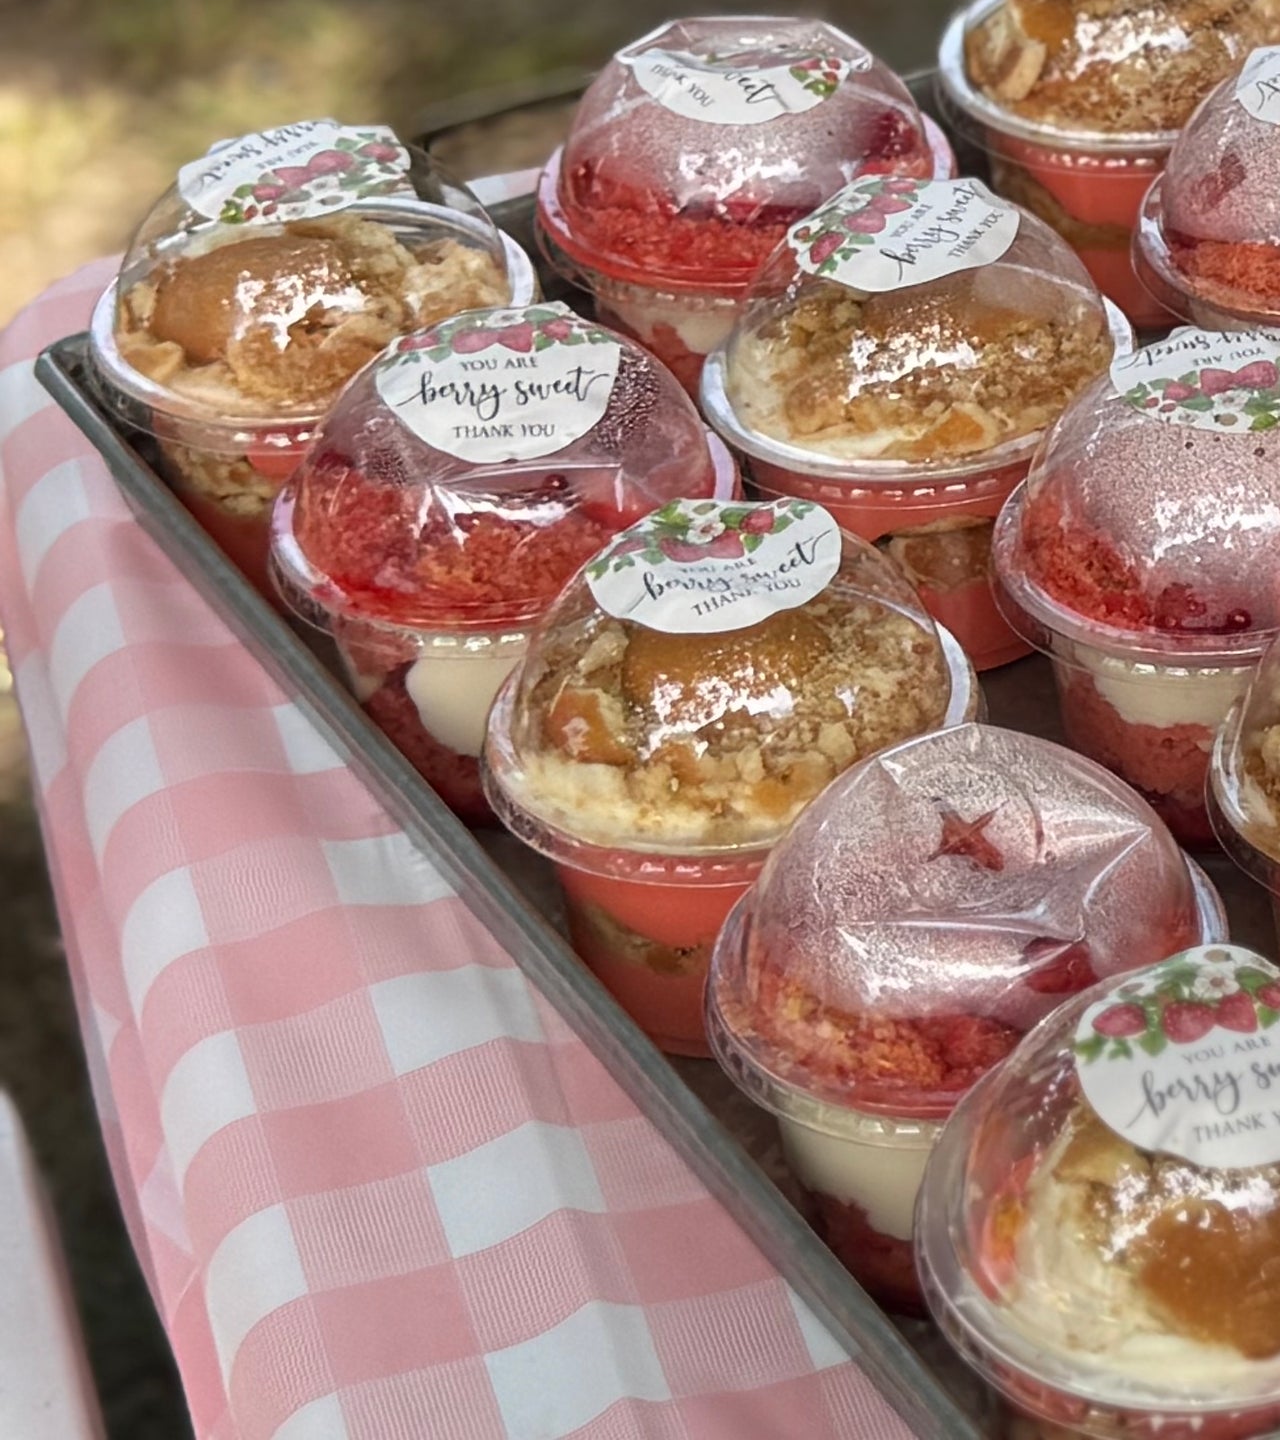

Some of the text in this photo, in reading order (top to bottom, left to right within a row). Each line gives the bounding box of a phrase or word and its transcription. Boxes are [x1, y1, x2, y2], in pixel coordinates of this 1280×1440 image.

[460, 356, 539, 373] YOU ARE
[1229, 346, 1267, 360] YOU
[394, 365, 611, 422] berry sweet
[451, 423, 556, 439] THANK YOU
[624, 570, 734, 614] berry
[766, 577, 802, 592] YOU
[1181, 1036, 1273, 1065] YOU ARE
[1124, 1069, 1245, 1130] berry
[1192, 1113, 1268, 1145] THANK
